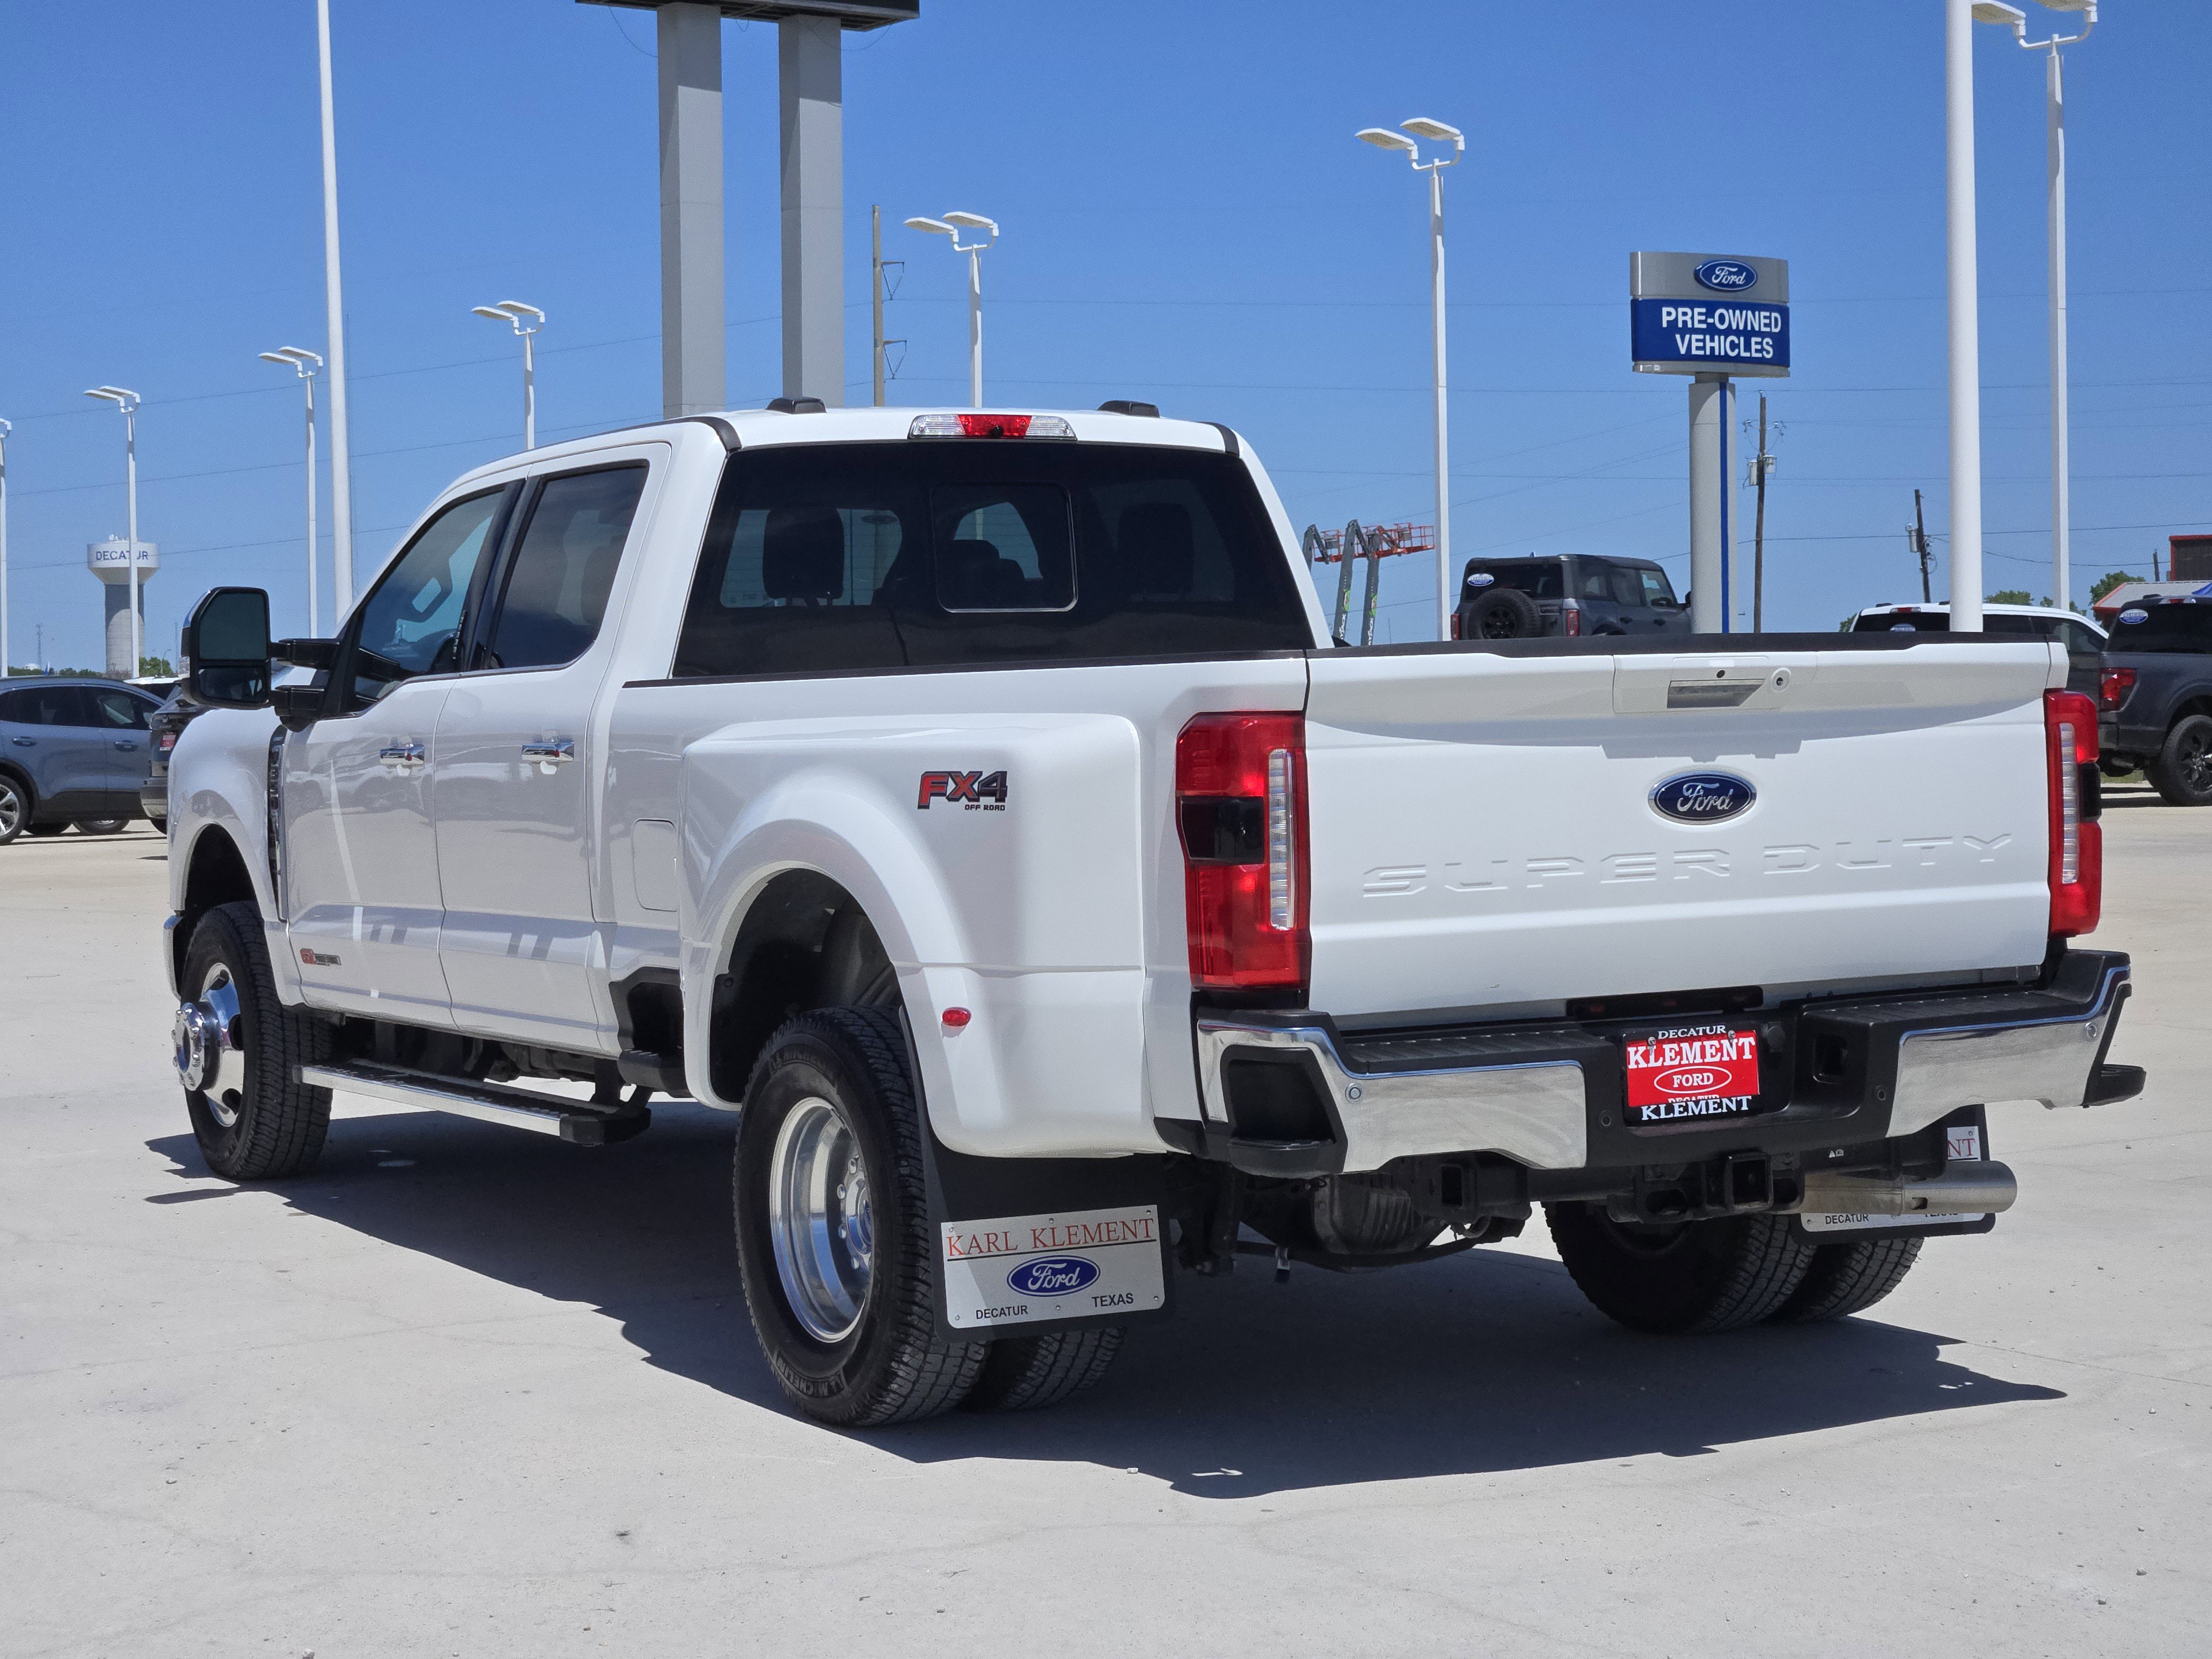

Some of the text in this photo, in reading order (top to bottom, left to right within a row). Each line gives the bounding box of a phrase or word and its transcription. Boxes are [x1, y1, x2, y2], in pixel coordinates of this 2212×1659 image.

[1712, 265, 1746, 285] Ford
[1662, 307, 1782, 333] PRE-OWNED
[1675, 333, 1774, 359] VEHICLES
[917, 771, 1008, 809] FX4
[1677, 782, 1734, 812] Ford
[1363, 833, 2012, 898] SUPER DUTY
[1657, 1025, 1726, 1040] DECATUR
[1627, 1036, 1756, 1069] KLEMENT
[1672, 1072, 1714, 1088] FORD
[1641, 1095, 1752, 1120] KLEMENT
[1825, 1214, 1869, 1225] DECATUR
[946, 1218, 1154, 1256] KARL KLEMENT
[1027, 1262, 1081, 1290] Ford
[975, 1305, 1029, 1319] DECATUR
[1092, 1292, 1134, 1308] TEXAS
[776, 1356, 829, 1397] MICHELIN
